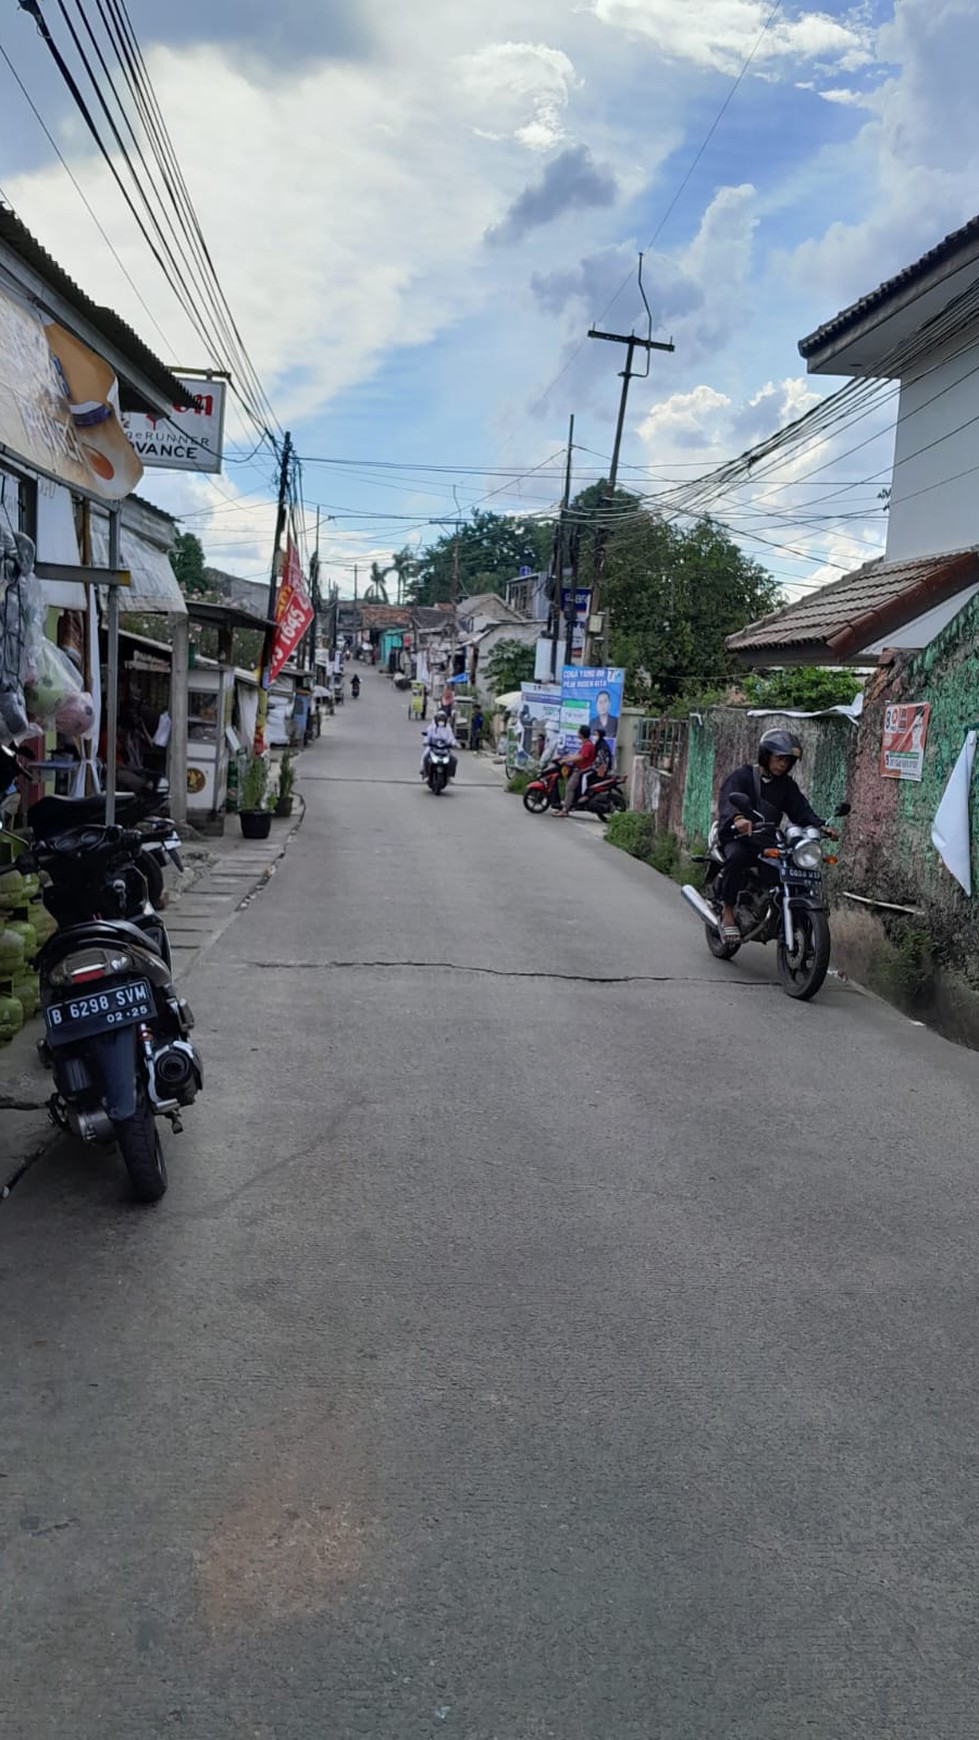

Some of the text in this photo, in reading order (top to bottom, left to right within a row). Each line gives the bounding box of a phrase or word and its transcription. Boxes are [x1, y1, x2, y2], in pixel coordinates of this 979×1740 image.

[51, 984, 147, 1025] B 6298 SVM
